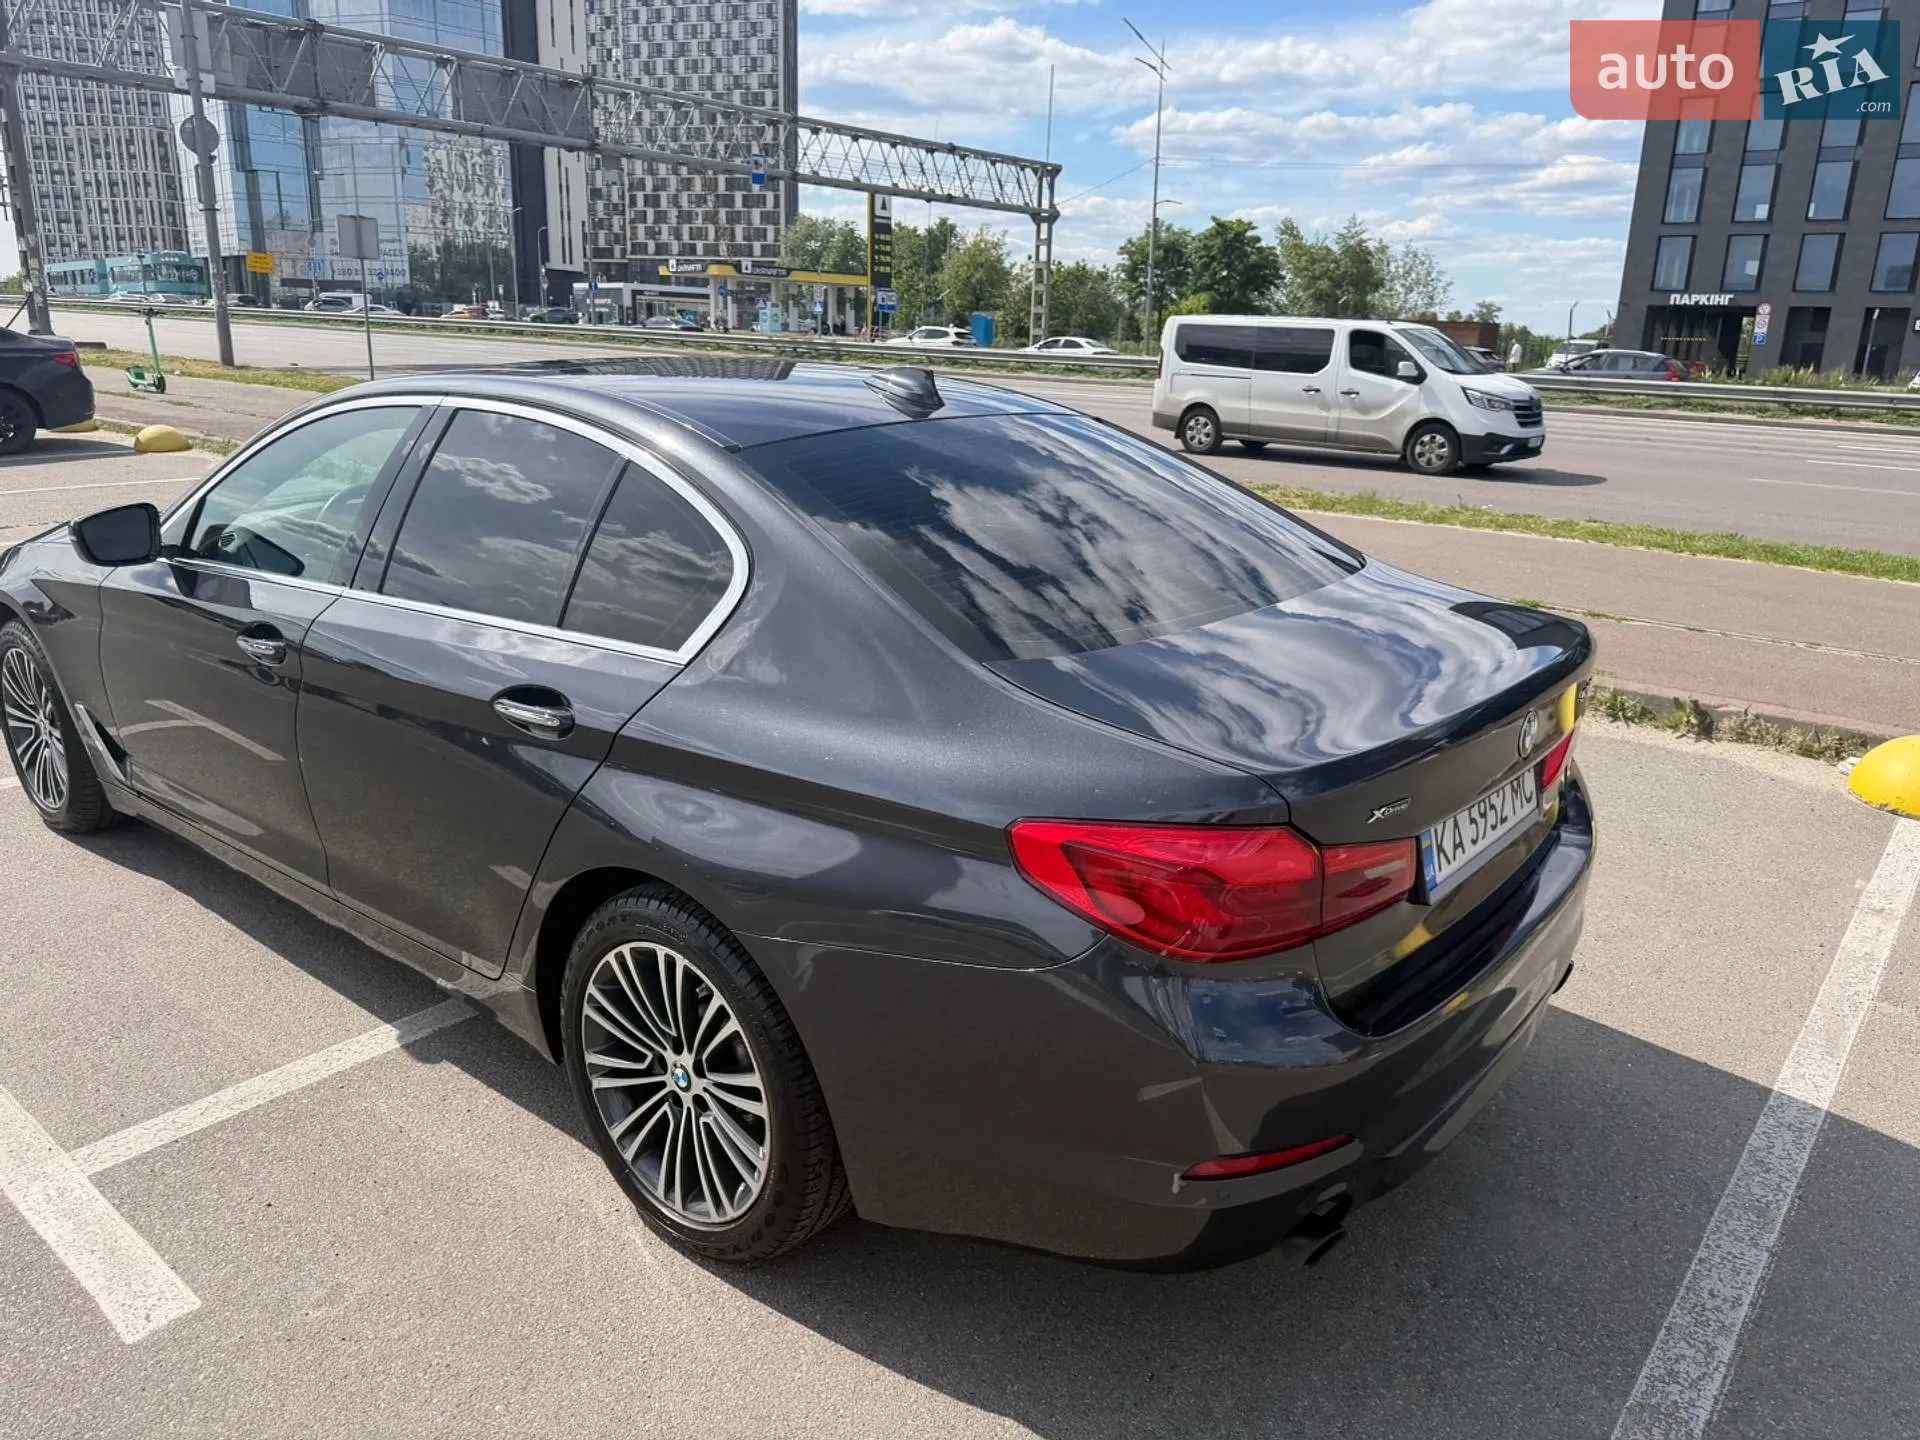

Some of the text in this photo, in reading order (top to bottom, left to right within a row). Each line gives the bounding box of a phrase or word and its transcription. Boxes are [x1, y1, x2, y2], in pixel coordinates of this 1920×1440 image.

[1669, 293, 1734, 306] ПАРКІНГ
[1434, 768, 1534, 873] KA 5952 MC
